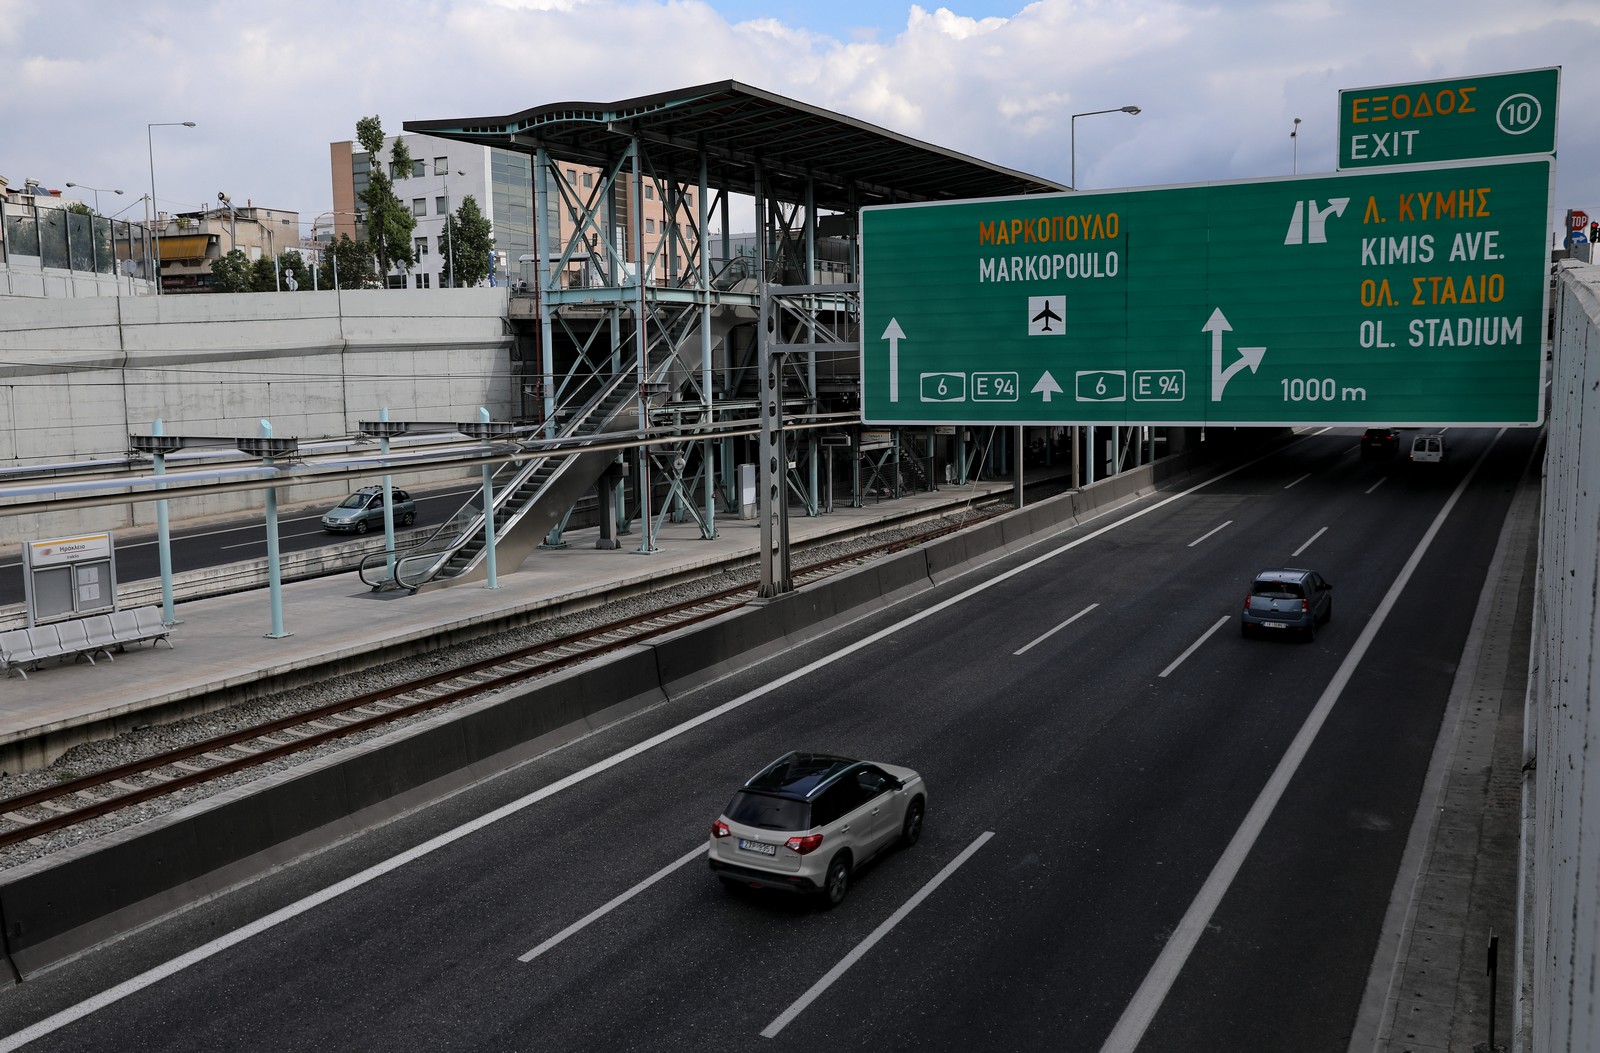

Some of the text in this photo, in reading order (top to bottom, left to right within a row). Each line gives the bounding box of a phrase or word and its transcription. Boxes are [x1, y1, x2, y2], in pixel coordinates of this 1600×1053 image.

[1352, 87, 1477, 123] ΕΞΟΔΟΣ
[1506, 102, 1532, 126] 10
[1351, 129, 1420, 160] EXIT
[1363, 187, 1491, 224] Λ. ΚΥΜΗΣ
[979, 212, 1119, 246] ΜΑΡΚΟΠΟΥΛΟ
[1570, 216, 1587, 227] TOP
[1361, 230, 1505, 266] KIMIS AVE.
[979, 251, 1119, 283] MARKOPOULO
[1360, 273, 1505, 307] ΟΛ. ΣΤΑΔΙΟ
[1359, 316, 1523, 348] OL. STADIUM
[937, 377, 948, 396] 6
[977, 377, 1015, 396] E 94
[1095, 376, 1107, 395] 6
[1139, 375, 1180, 395] E 94
[1281, 378, 1366, 401] 1000 m
